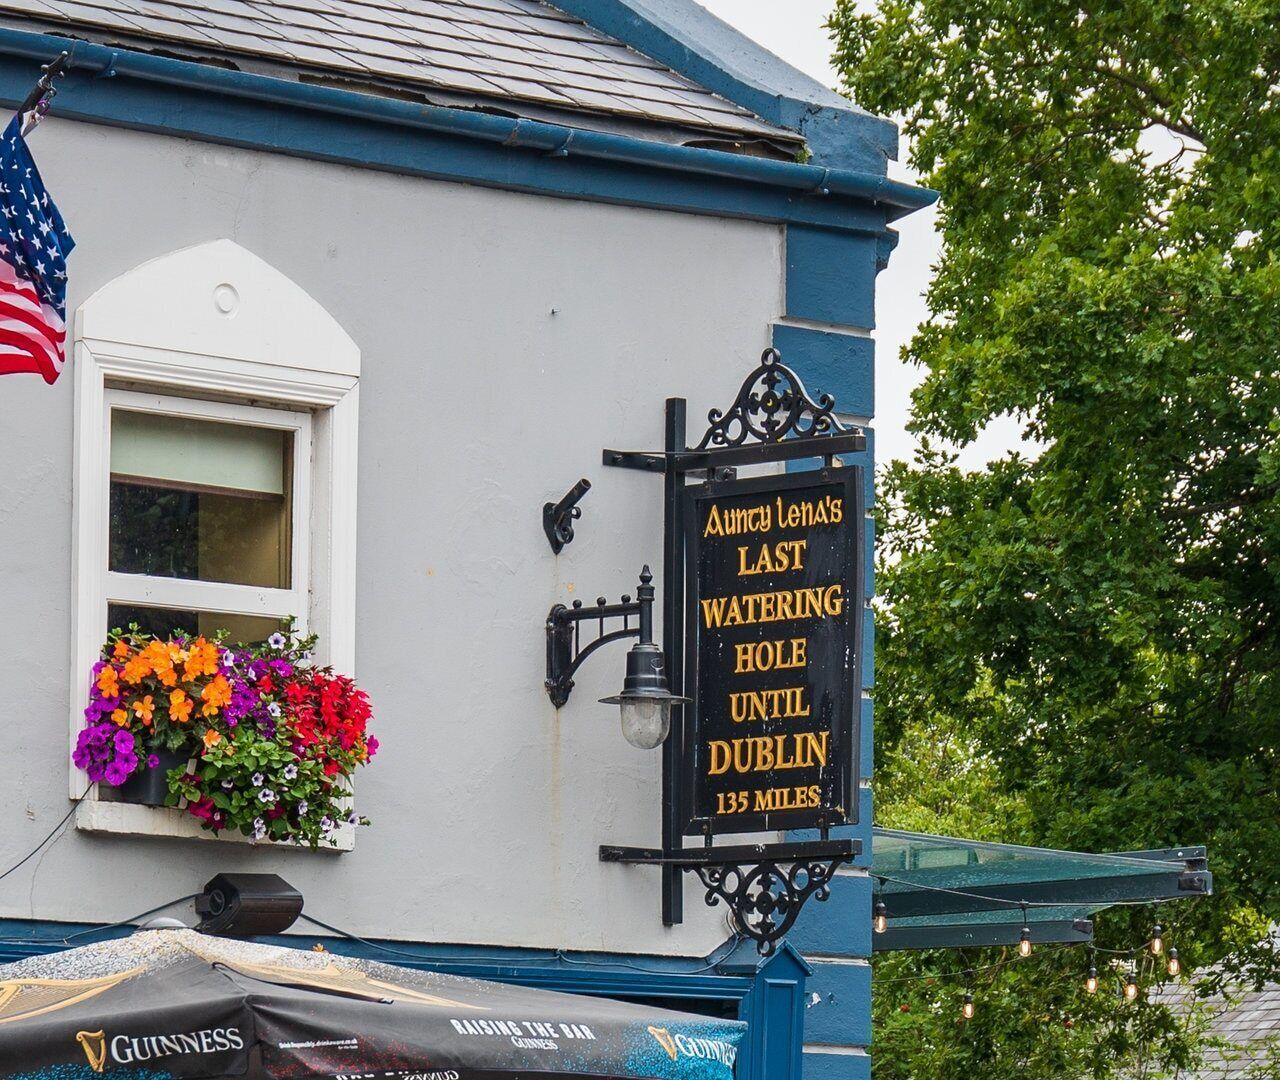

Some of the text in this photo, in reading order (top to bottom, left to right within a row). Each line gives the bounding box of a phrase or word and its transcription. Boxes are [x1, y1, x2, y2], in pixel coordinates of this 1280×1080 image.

[737, 539, 807, 577] LAST
[700, 584, 844, 629] WATERING
[734, 637, 807, 674] HOLE
[729, 686, 810, 723] UNTIL
[708, 730, 830, 776] DUBLIN
[716, 785, 821, 815] 135 MILES
[110, 1028, 245, 1065] GUINNESS
[450, 1019, 596, 1040] RAISING THE BAR
[511, 1035, 559, 1050] GUINNESS
